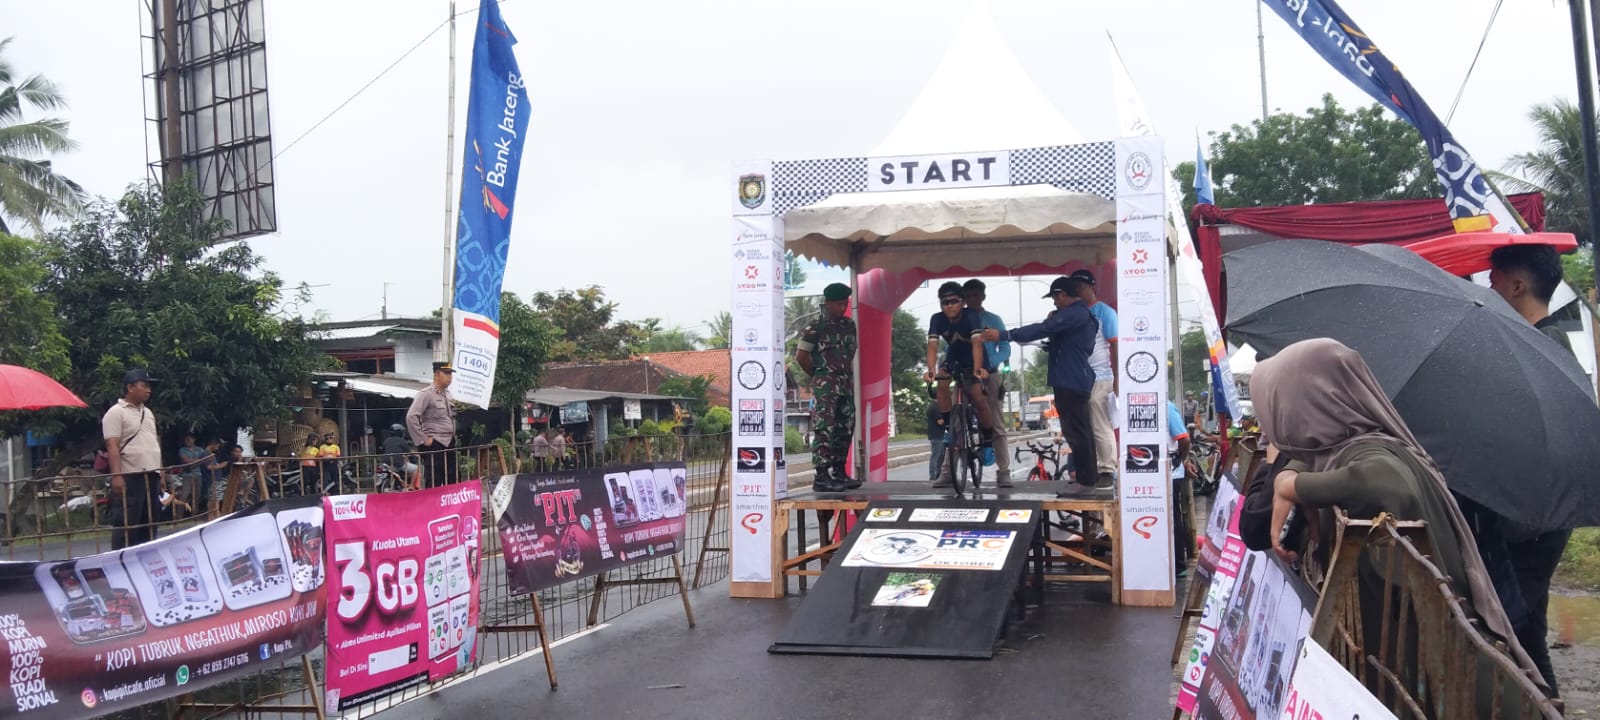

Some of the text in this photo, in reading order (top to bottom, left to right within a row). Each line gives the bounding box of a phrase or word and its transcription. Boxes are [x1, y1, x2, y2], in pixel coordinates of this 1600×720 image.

[486, 70, 527, 188] Bank Jateng
[880, 157, 997, 185] START
[1129, 405, 1156, 420] PITSHOP
[743, 485, 761, 493] PIT
[1133, 486, 1153, 495] PIT
[350, 500, 364, 515] 4G
[1126, 505, 1165, 513] smartfren
[372, 538, 398, 552] Kuota
[397, 535, 420, 548] Utama
[937, 538, 1006, 549] PRC
[334, 541, 419, 618] 3 GB
[2, 627, 31, 641] KOPI
[356, 629, 386, 645] Unlimited
[8, 636, 47, 655] MURNI
[106, 648, 137, 672] KOPI
[138, 636, 186, 663] TUBRUK
[11, 650, 44, 669] 100%
[350, 664, 357, 674] Di
[357, 662, 368, 673] Sini
[10, 664, 41, 684] KOPI
[11, 678, 46, 698] TRADI
[17, 690, 59, 712] SIONAL
